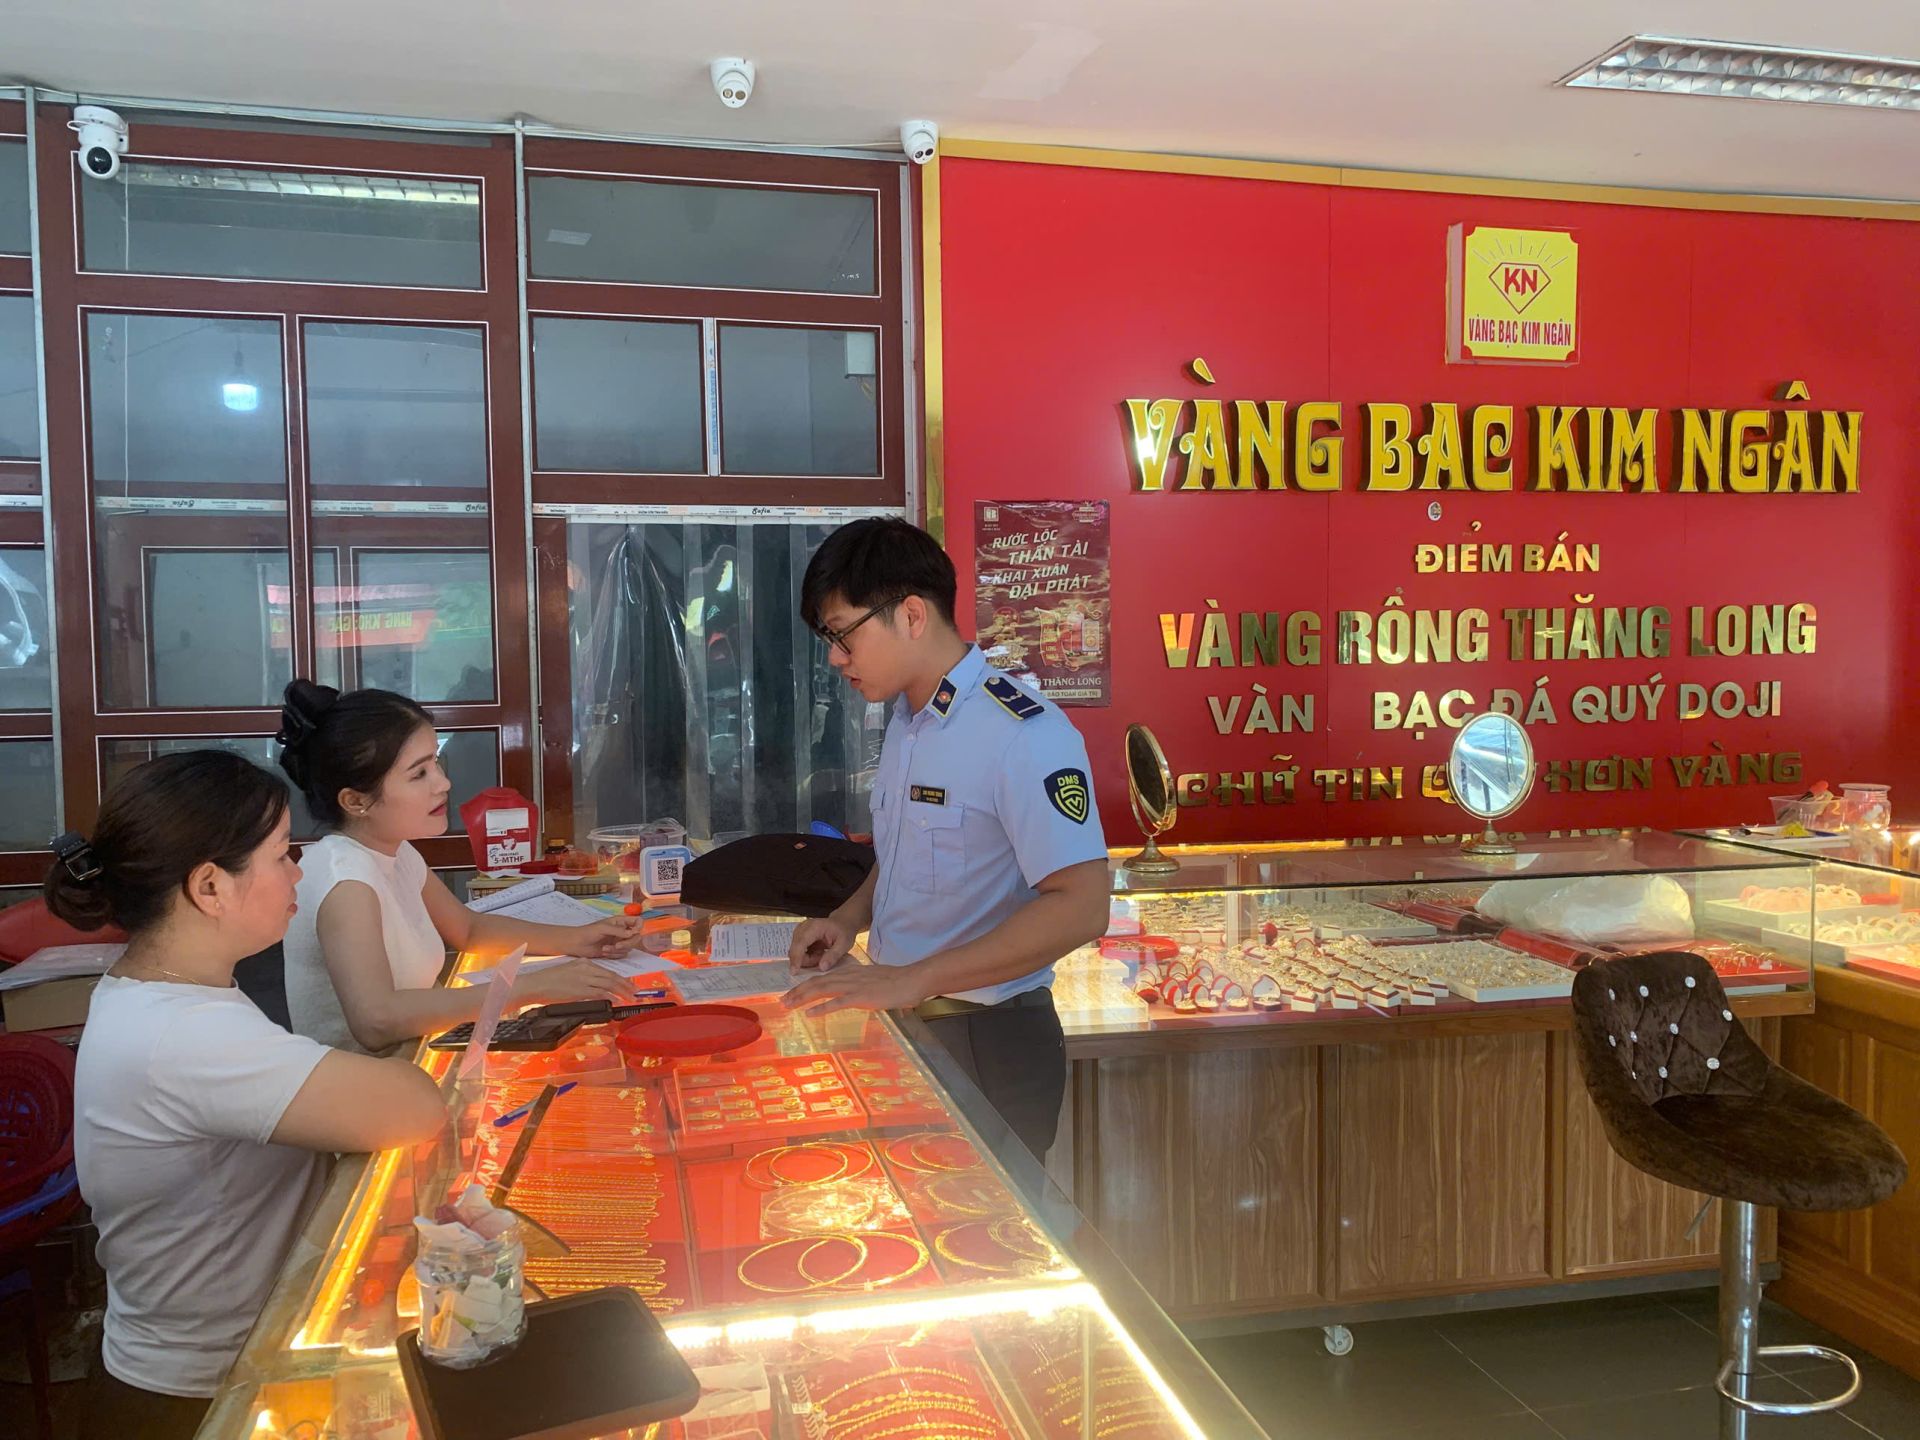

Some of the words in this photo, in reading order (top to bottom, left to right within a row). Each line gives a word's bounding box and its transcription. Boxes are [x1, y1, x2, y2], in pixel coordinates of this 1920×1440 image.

[1504, 267, 1538, 296] KN
[1469, 313, 1495, 342] VÀNG
[1498, 319, 1518, 348] BẠC
[1521, 321, 1541, 345] KIM
[1543, 318, 1571, 346] NGÂN
[1126, 357, 1344, 491] VÀNG
[1536, 405, 1660, 493] KIM
[1678, 380, 1864, 493] NGÂN
[1033, 528, 1058, 544] LỘC
[1523, 531, 1600, 572] BÁN
[992, 569, 1027, 585] KHAI
[1031, 563, 1069, 580] XUÂN
[1159, 599, 1322, 668] VÀNG
[1503, 593, 1672, 660] THĂNG
[1690, 602, 1817, 657] LONG
[1043, 676, 1075, 687] THĂNG
[1077, 676, 1102, 686] LONG
[1207, 683, 1315, 734] VÀN
[1374, 689, 1475, 740] BẠC
[1490, 676, 1557, 725] ĐÁ
[1571, 673, 1666, 724] QUÝ
[1679, 680, 1782, 720] DOJI
[1057, 774, 1080, 787] DMS
[1176, 754, 1300, 807] CHỮ
[1544, 755, 1654, 793] HƠN
[1671, 741, 1802, 788] VÀNG
[494, 855, 525, 865] 5-MTHF
